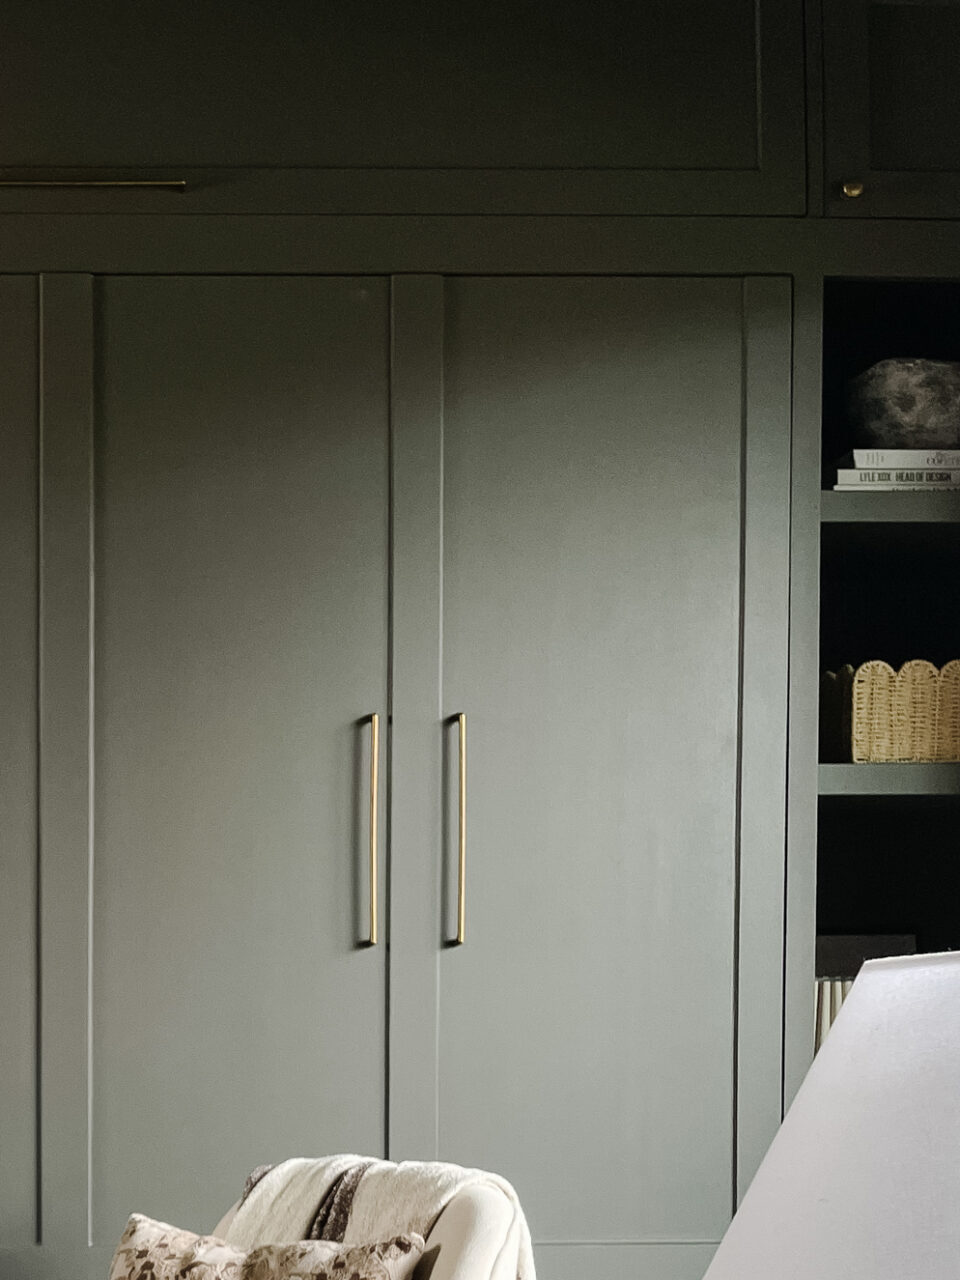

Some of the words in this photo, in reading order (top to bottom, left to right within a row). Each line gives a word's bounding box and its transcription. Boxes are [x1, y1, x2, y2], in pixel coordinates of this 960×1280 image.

[860, 472, 875, 482] LYLE
[895, 472, 915, 482] HEAD
[916, 472, 924, 482] OF
[926, 472, 951, 482] DESIGN
